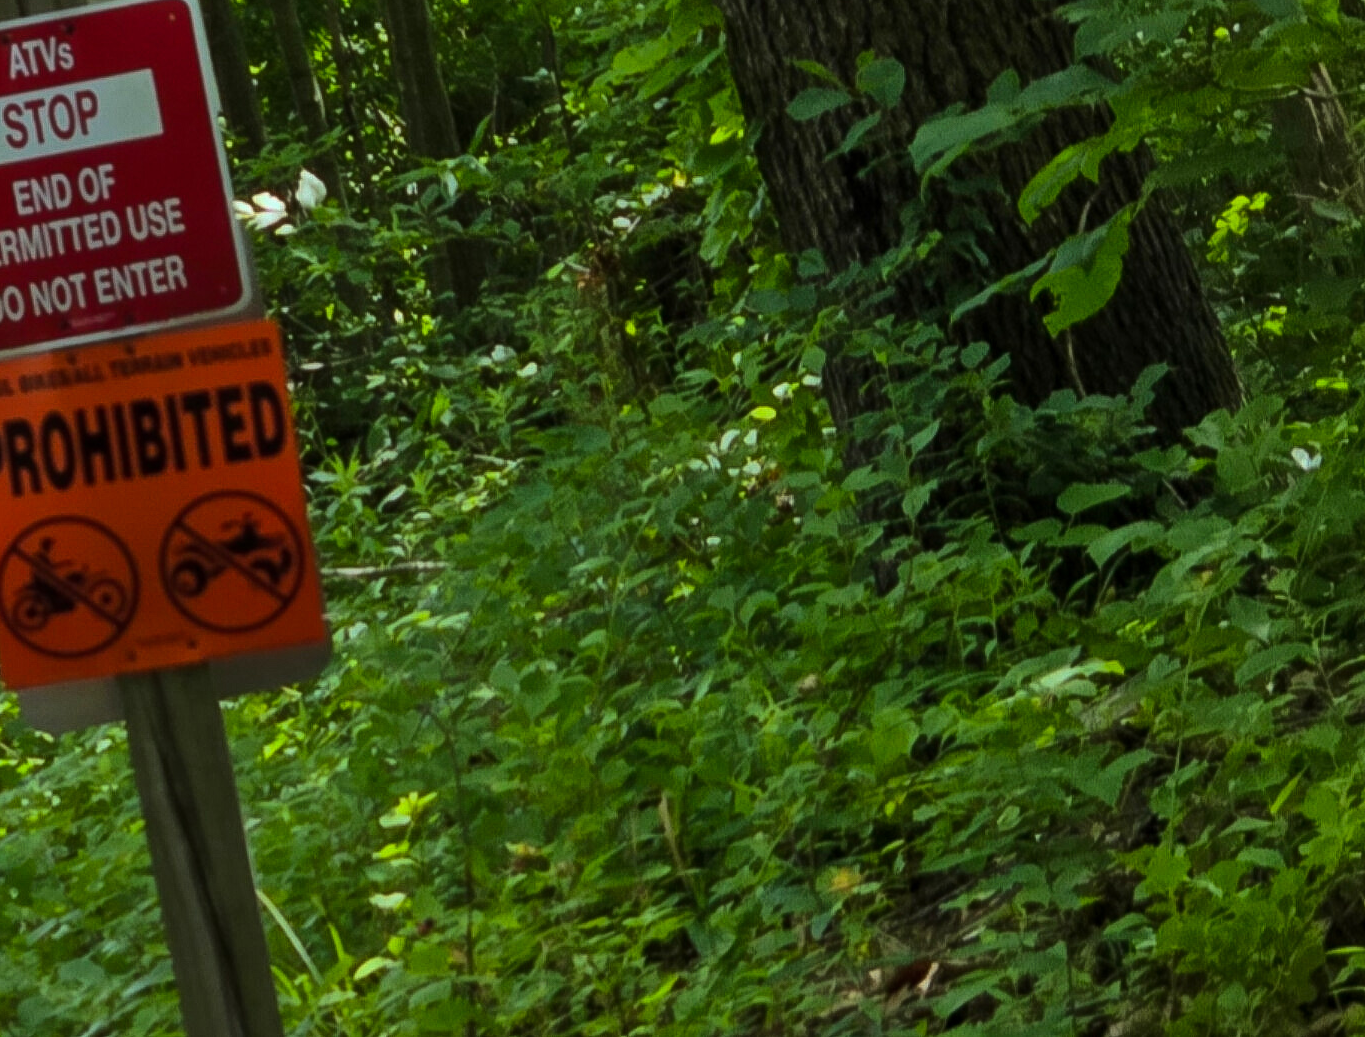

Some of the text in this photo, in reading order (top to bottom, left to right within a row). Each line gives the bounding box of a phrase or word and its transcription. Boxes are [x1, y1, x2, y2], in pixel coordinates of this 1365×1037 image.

[9, 36, 74, 80] ATVs
[2, 89, 99, 149] STOP
[12, 163, 116, 216] END OF
[126, 197, 186, 241] USE
[29, 272, 87, 317] NOT
[93, 254, 188, 305] ENTER
